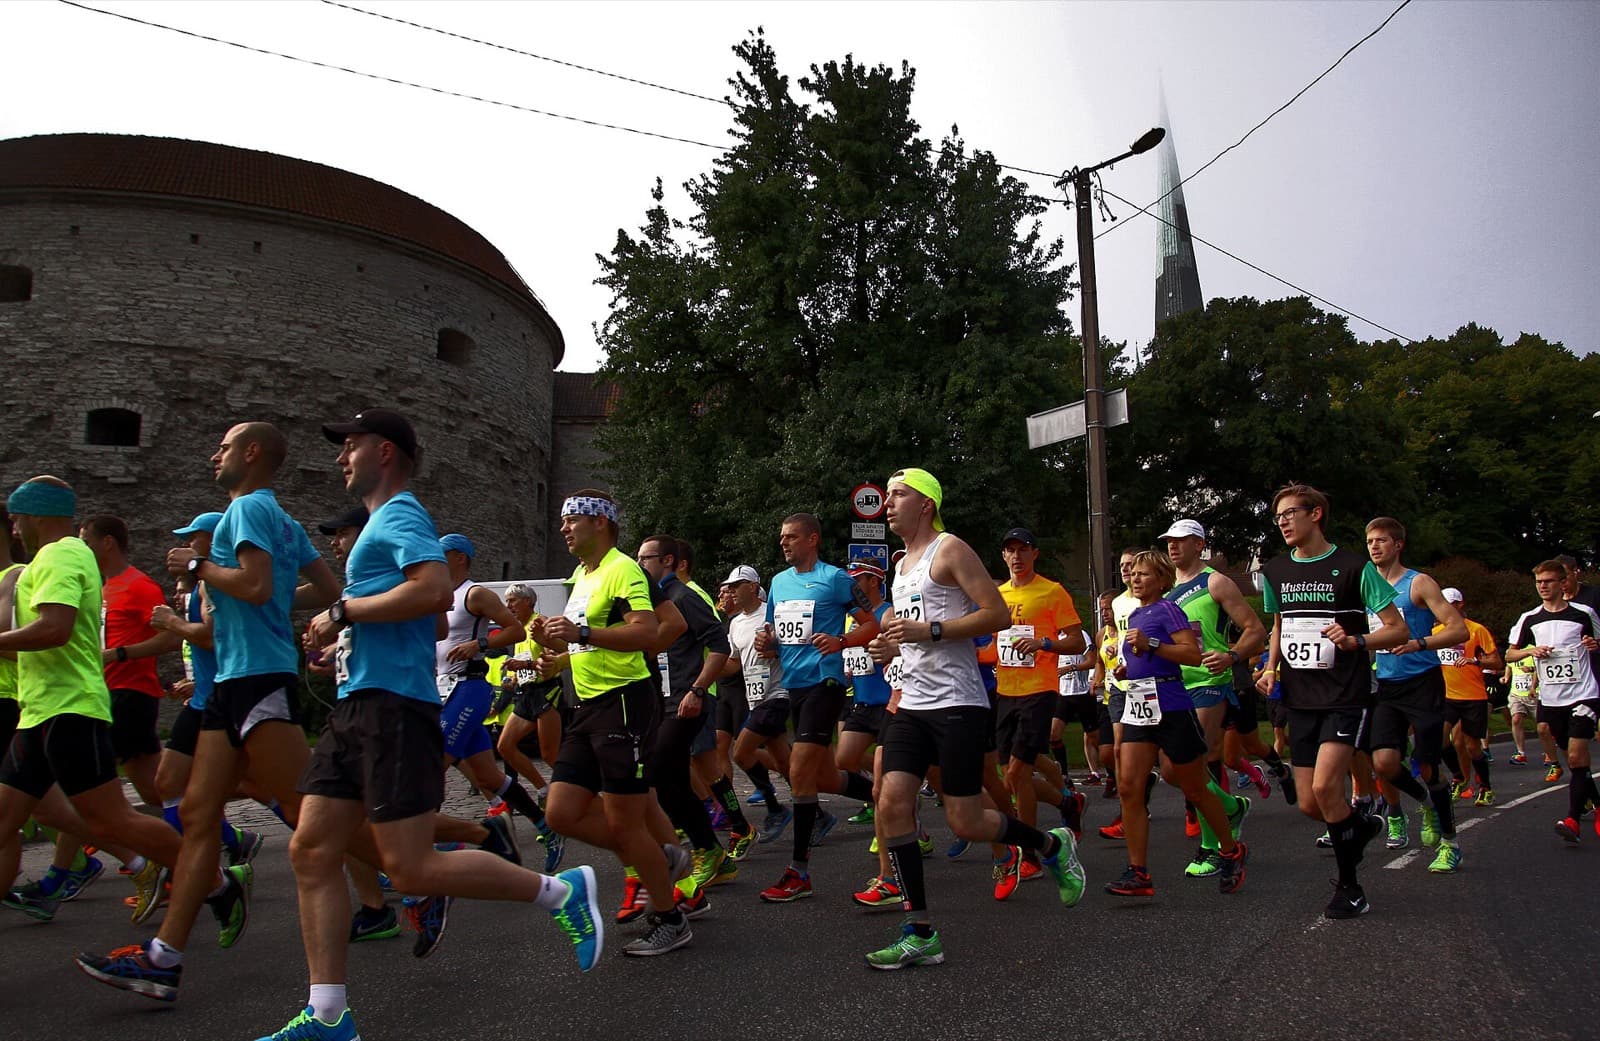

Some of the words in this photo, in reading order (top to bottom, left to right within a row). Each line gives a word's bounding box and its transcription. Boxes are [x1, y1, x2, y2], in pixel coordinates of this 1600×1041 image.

[1280, 580, 1335, 593] Musician
[1281, 592, 1335, 604] RUNNING
[779, 622, 804, 639] 395
[1287, 643, 1321, 662] 851
[1440, 650, 1459, 662] 830
[846, 656, 868, 671] 4343
[1546, 664, 1574, 679] 623
[746, 682, 765, 696] 733
[1515, 682, 1529, 690] 612
[1130, 701, 1153, 719] 426
[447, 706, 475, 747] skinfit
